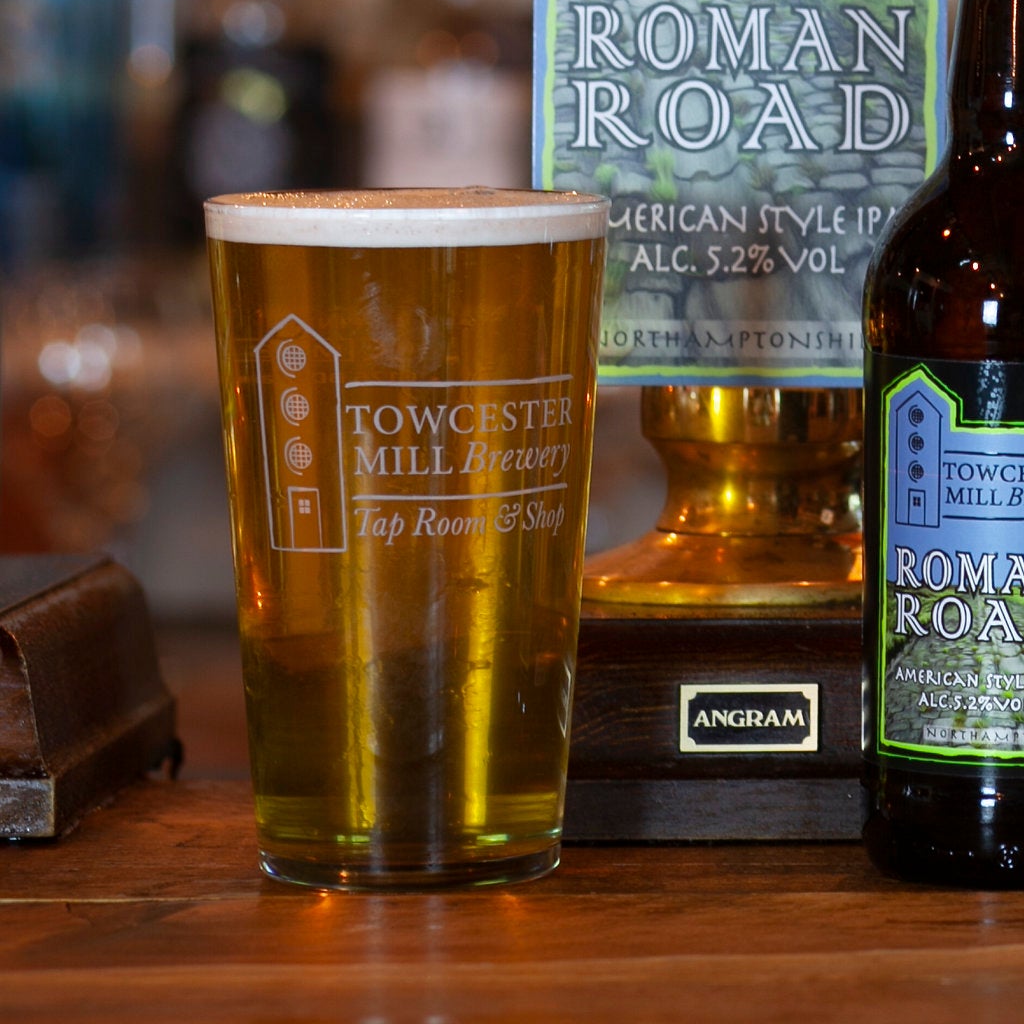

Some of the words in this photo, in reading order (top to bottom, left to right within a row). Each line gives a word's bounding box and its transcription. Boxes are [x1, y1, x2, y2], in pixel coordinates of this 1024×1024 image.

[570, 2, 915, 79] ROMAN
[569, 77, 912, 153] ROAD
[608, 202, 748, 233] MERICAN
[758, 204, 846, 237] STYLE
[629, 243, 697, 273] ALC.
[706, 243, 775, 276] 5.2%
[777, 245, 845, 274] VOL
[345, 396, 573, 436] TOWCESTER
[354, 445, 453, 476] MILL
[459, 440, 571, 477] Brewery
[945, 487, 1002, 507] MILL
[353, 506, 403, 545] Tap
[412, 506, 486, 537] Room
[494, 503, 522, 533] &
[523, 500, 565, 536] Shop
[895, 666, 979, 689] AMERICAN
[693, 709, 806, 727] ANGRAM
